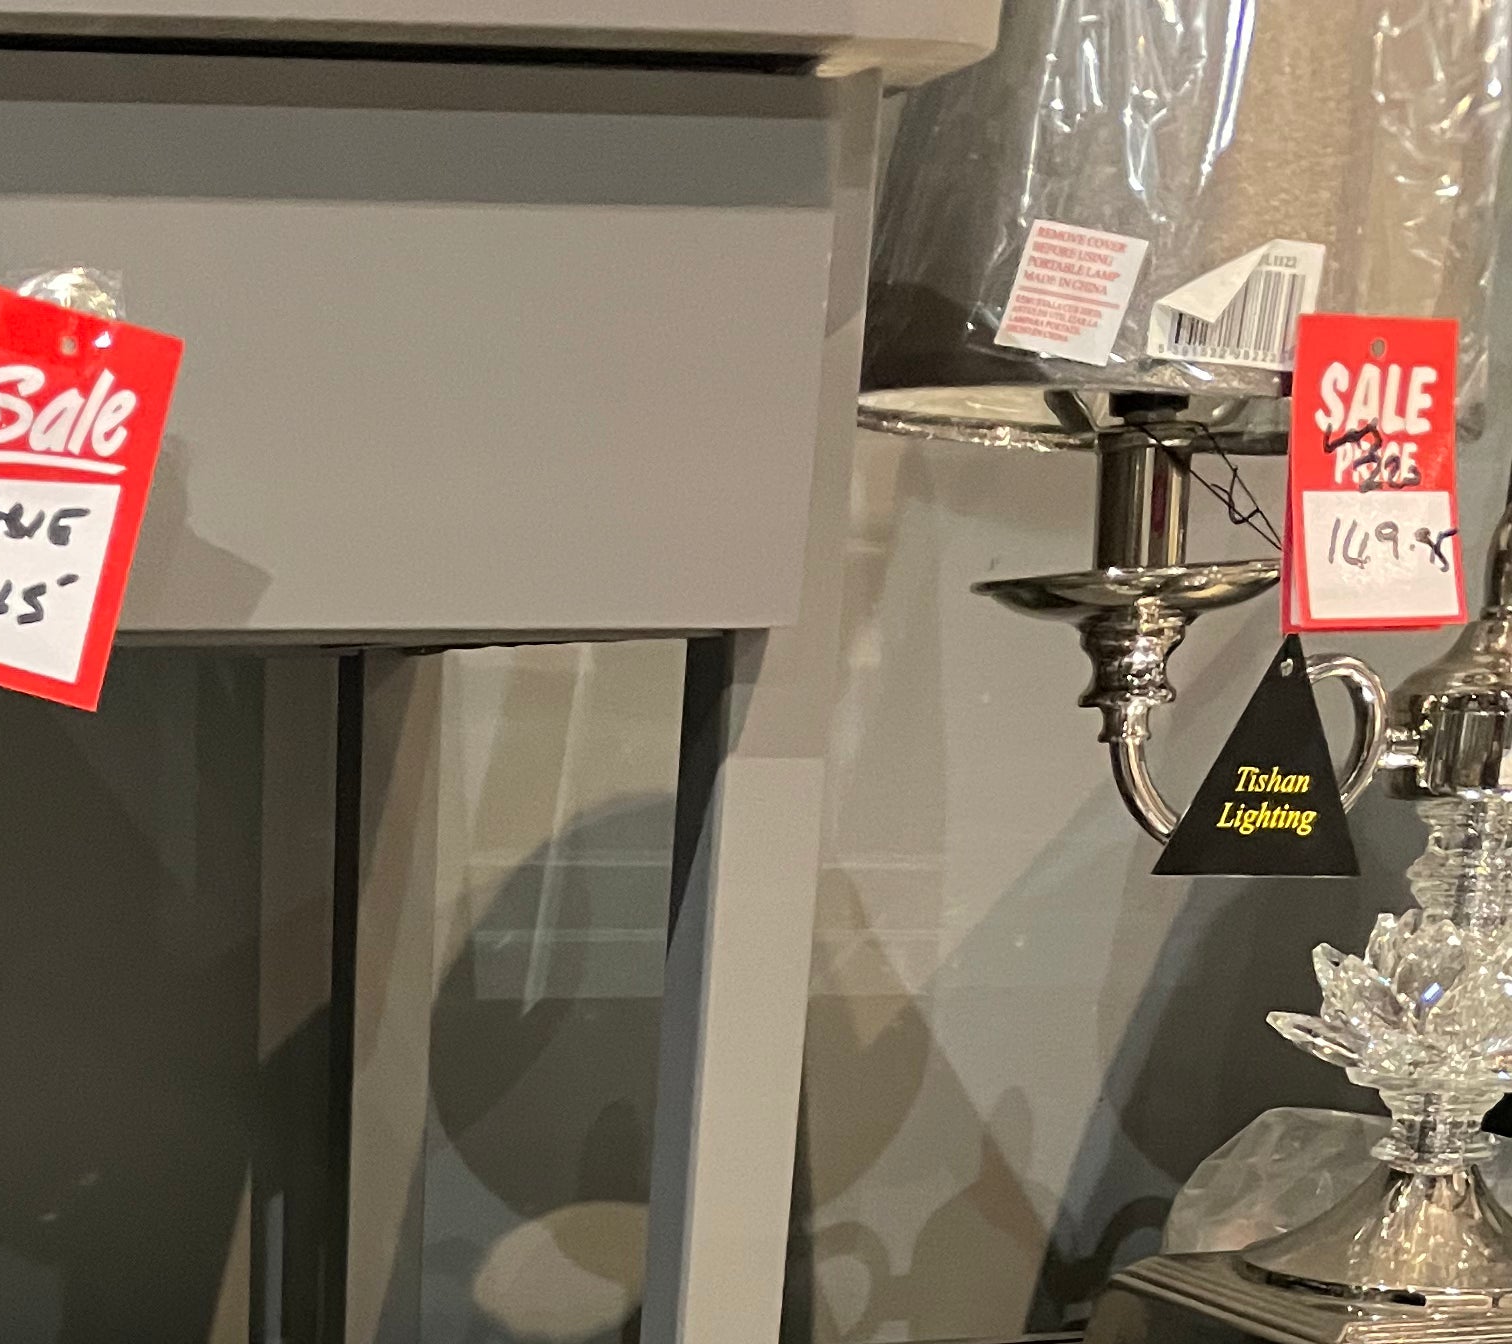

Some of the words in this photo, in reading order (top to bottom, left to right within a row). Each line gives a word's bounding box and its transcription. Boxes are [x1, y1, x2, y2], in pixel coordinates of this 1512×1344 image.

[1315, 361, 1437, 435] SALE
[1235, 766, 1310, 793] Tishan
[1216, 802, 1317, 836] Lighting
